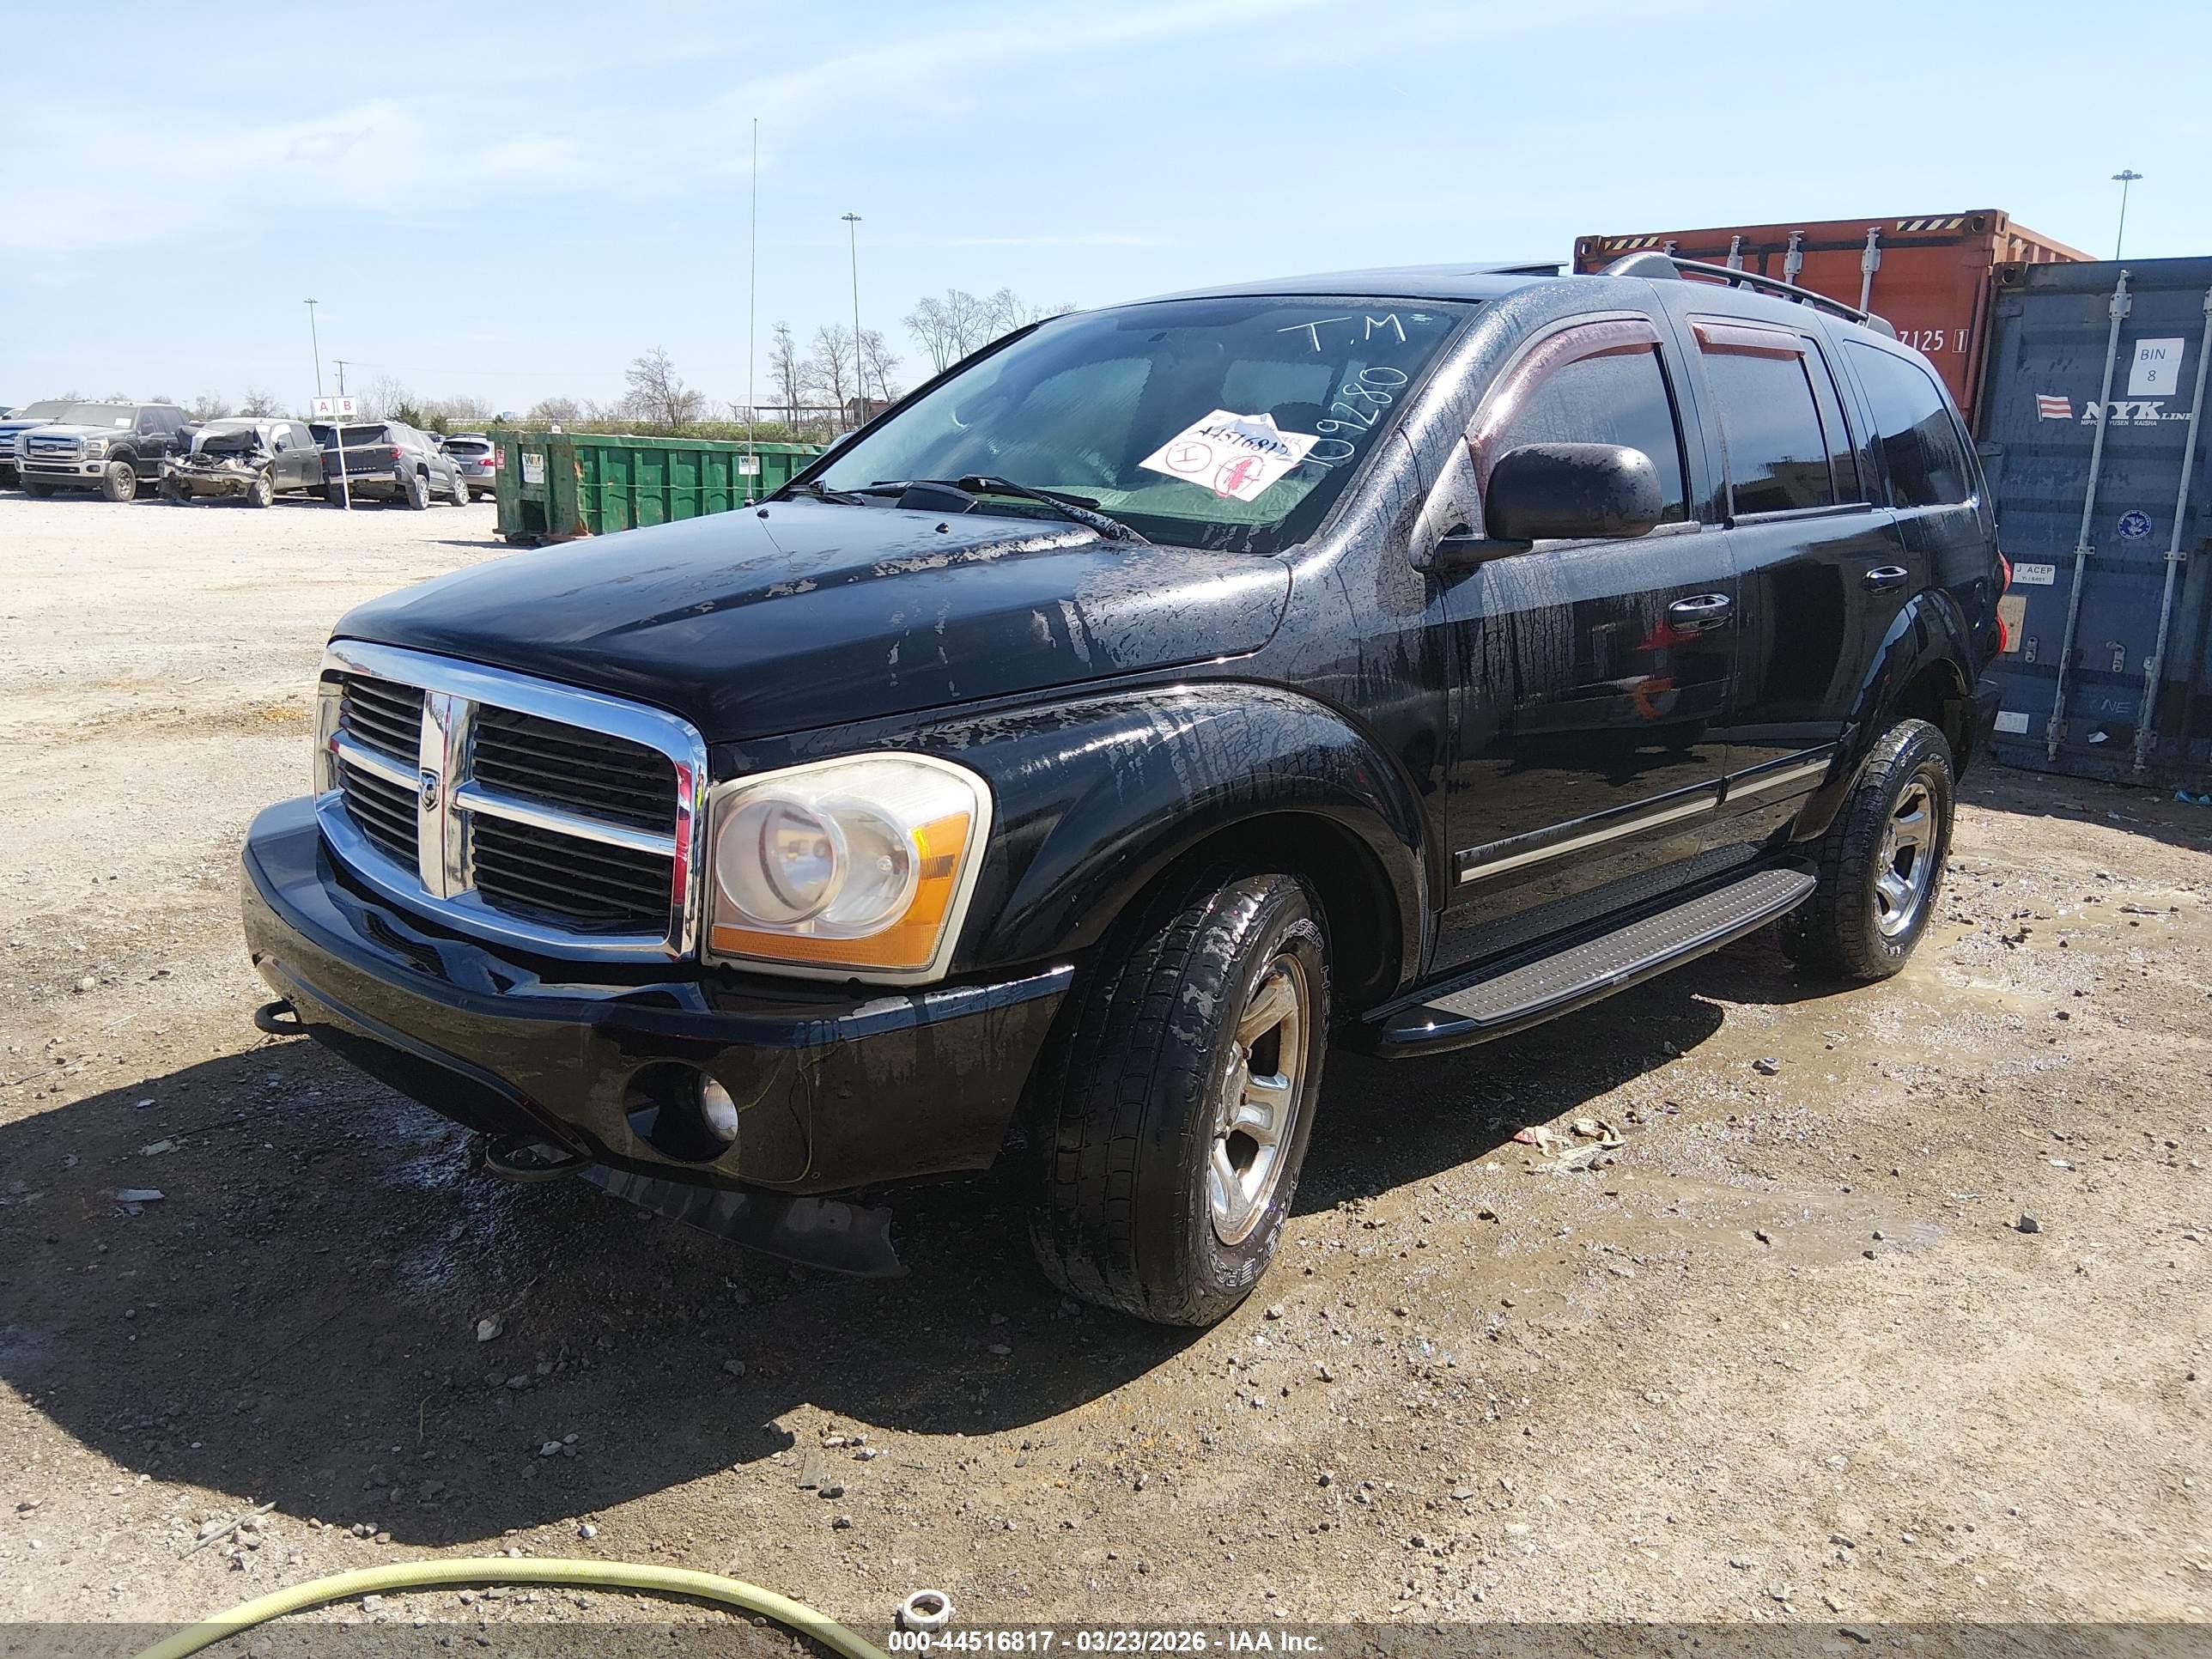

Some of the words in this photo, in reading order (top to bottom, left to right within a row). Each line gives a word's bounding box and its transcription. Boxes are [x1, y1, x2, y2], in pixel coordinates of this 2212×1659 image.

[1899, 330, 1945, 351] 7125
[2140, 348, 2166, 361] BIN
[2147, 370, 2157, 382] 8
[319, 401, 329, 412] A
[343, 400, 352, 411] B
[2081, 401, 2165, 420] NYK
[2027, 566, 2053, 574] ACEP
